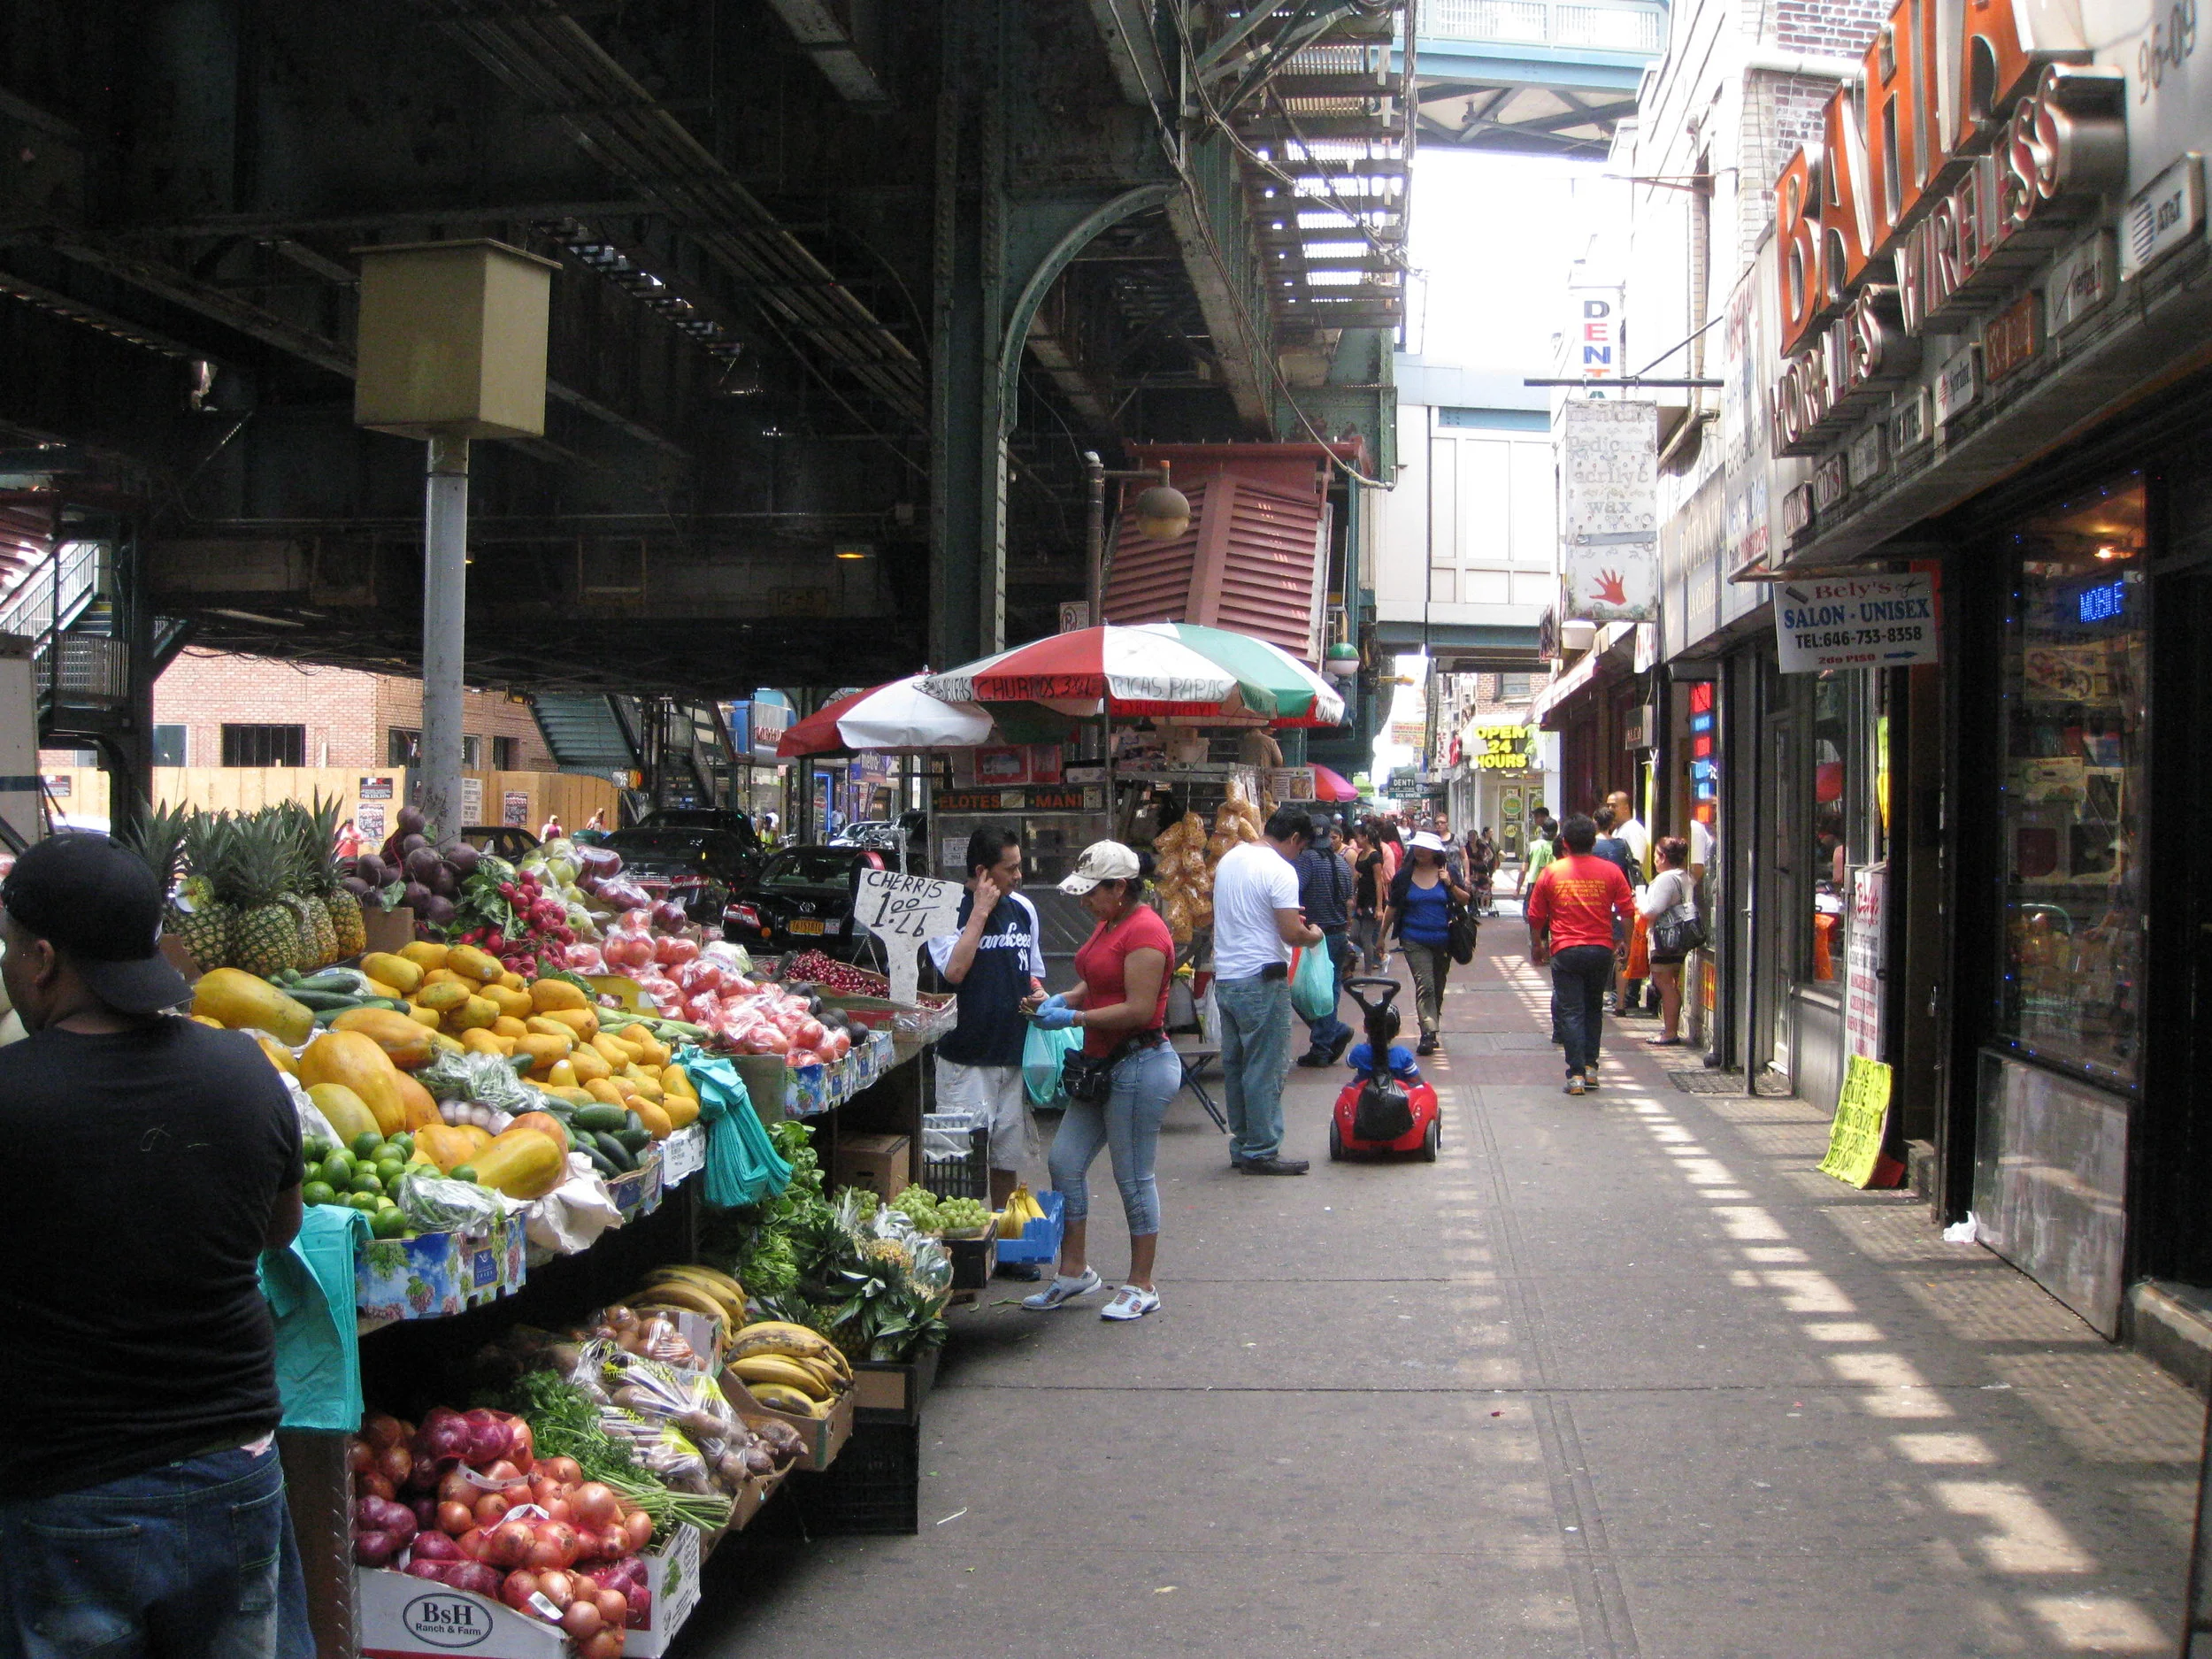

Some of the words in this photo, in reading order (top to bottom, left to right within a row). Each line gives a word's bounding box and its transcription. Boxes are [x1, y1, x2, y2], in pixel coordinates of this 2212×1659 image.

[1894, 63, 2060, 336] WIRELESS
[1587, 501, 1632, 514] wax
[1816, 580, 1892, 599] Bely's
[1784, 604, 1846, 629] SALON
[1860, 598, 1931, 622] UNISEX
[977, 677, 1056, 701] CHURROS
[1110, 674, 1164, 699] RICAS
[1169, 676, 1225, 701] PAPAS
[1474, 725, 1528, 740] OPEN
[1487, 740, 1512, 754] 24
[1475, 753, 1527, 769] HOURS
[938, 795, 1001, 810] ELOTES
[416, 1622, 445, 1633] Ranch
[457, 1626, 481, 1636] Farm
